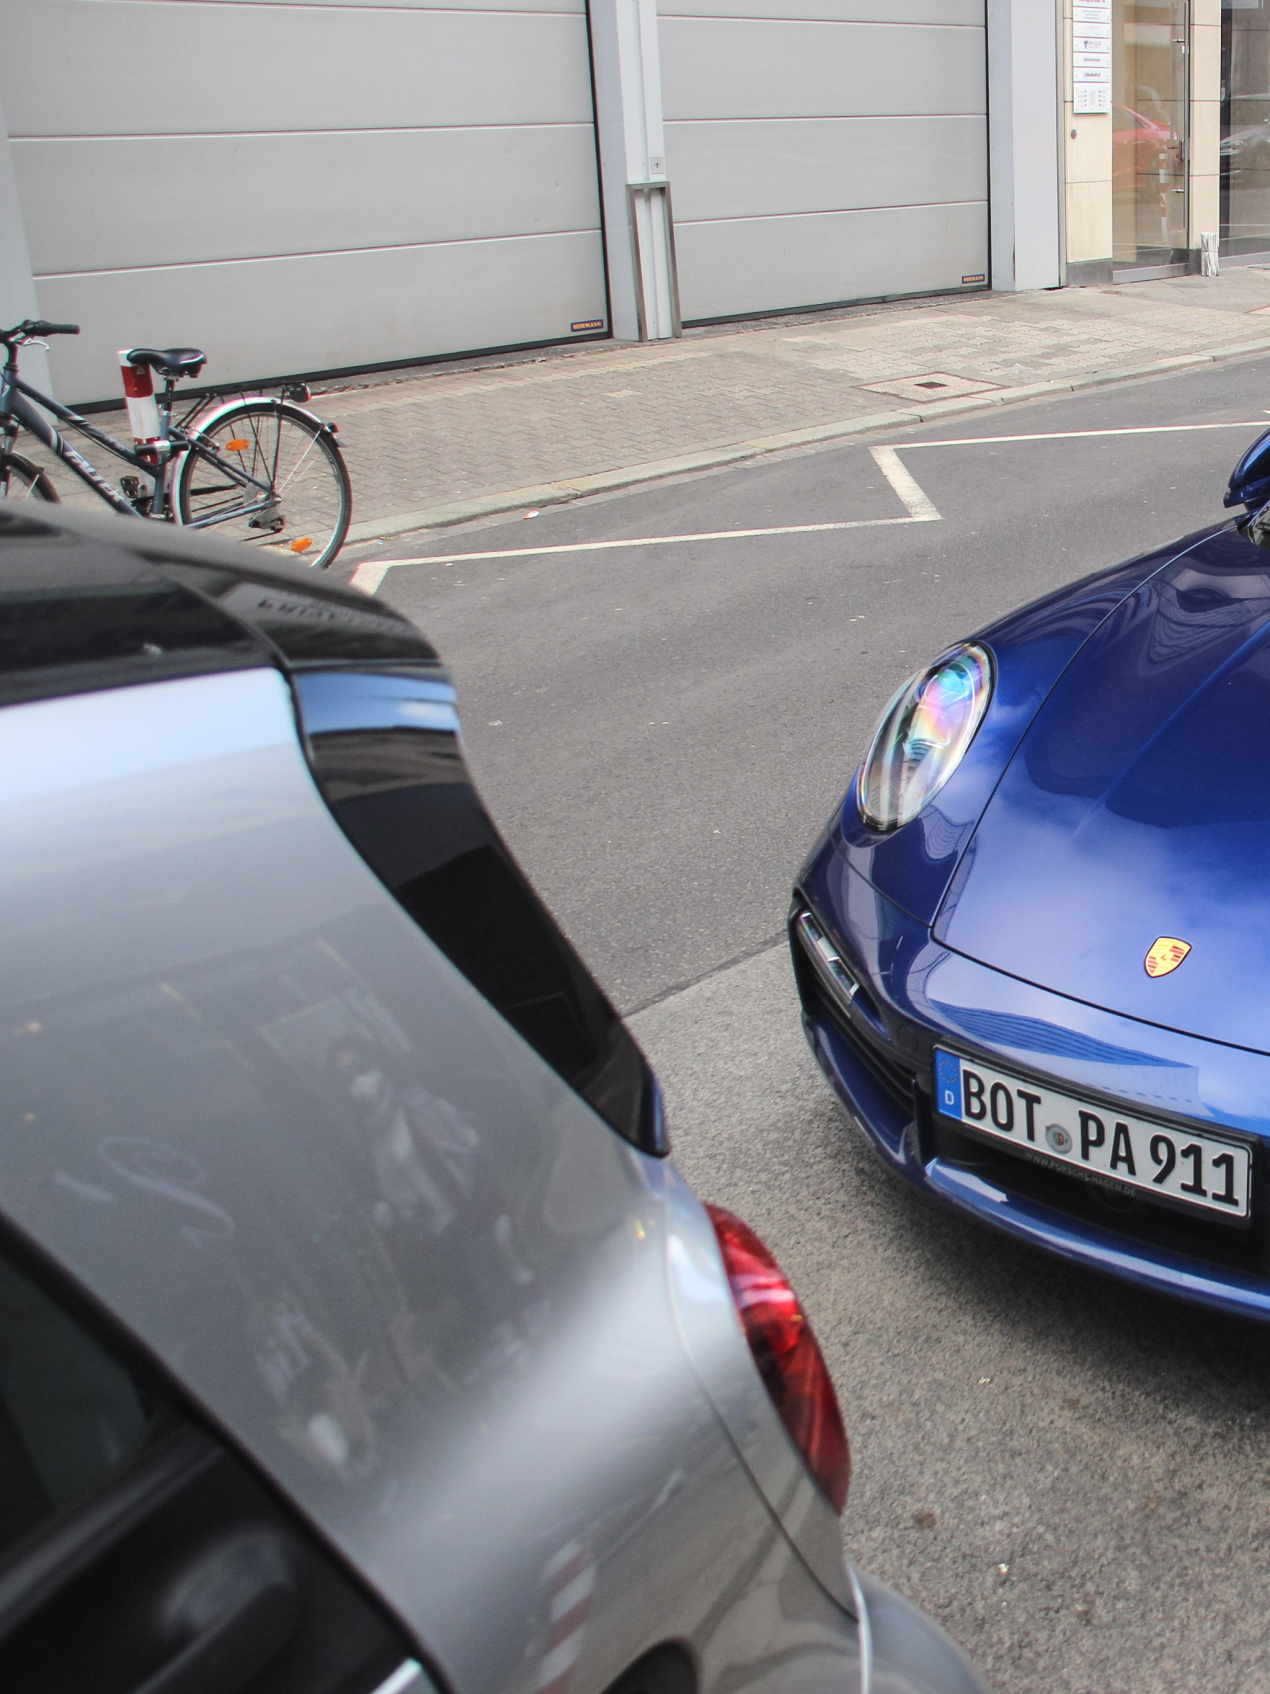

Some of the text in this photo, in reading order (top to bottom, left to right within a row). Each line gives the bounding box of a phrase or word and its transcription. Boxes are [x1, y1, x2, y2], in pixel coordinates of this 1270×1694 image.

[944, 1089, 955, 1106] D
[962, 1068, 1239, 1207] BOT PA 911
[1024, 1151, 1137, 1197] WWW.PORSCHE-HAGEN.DE
